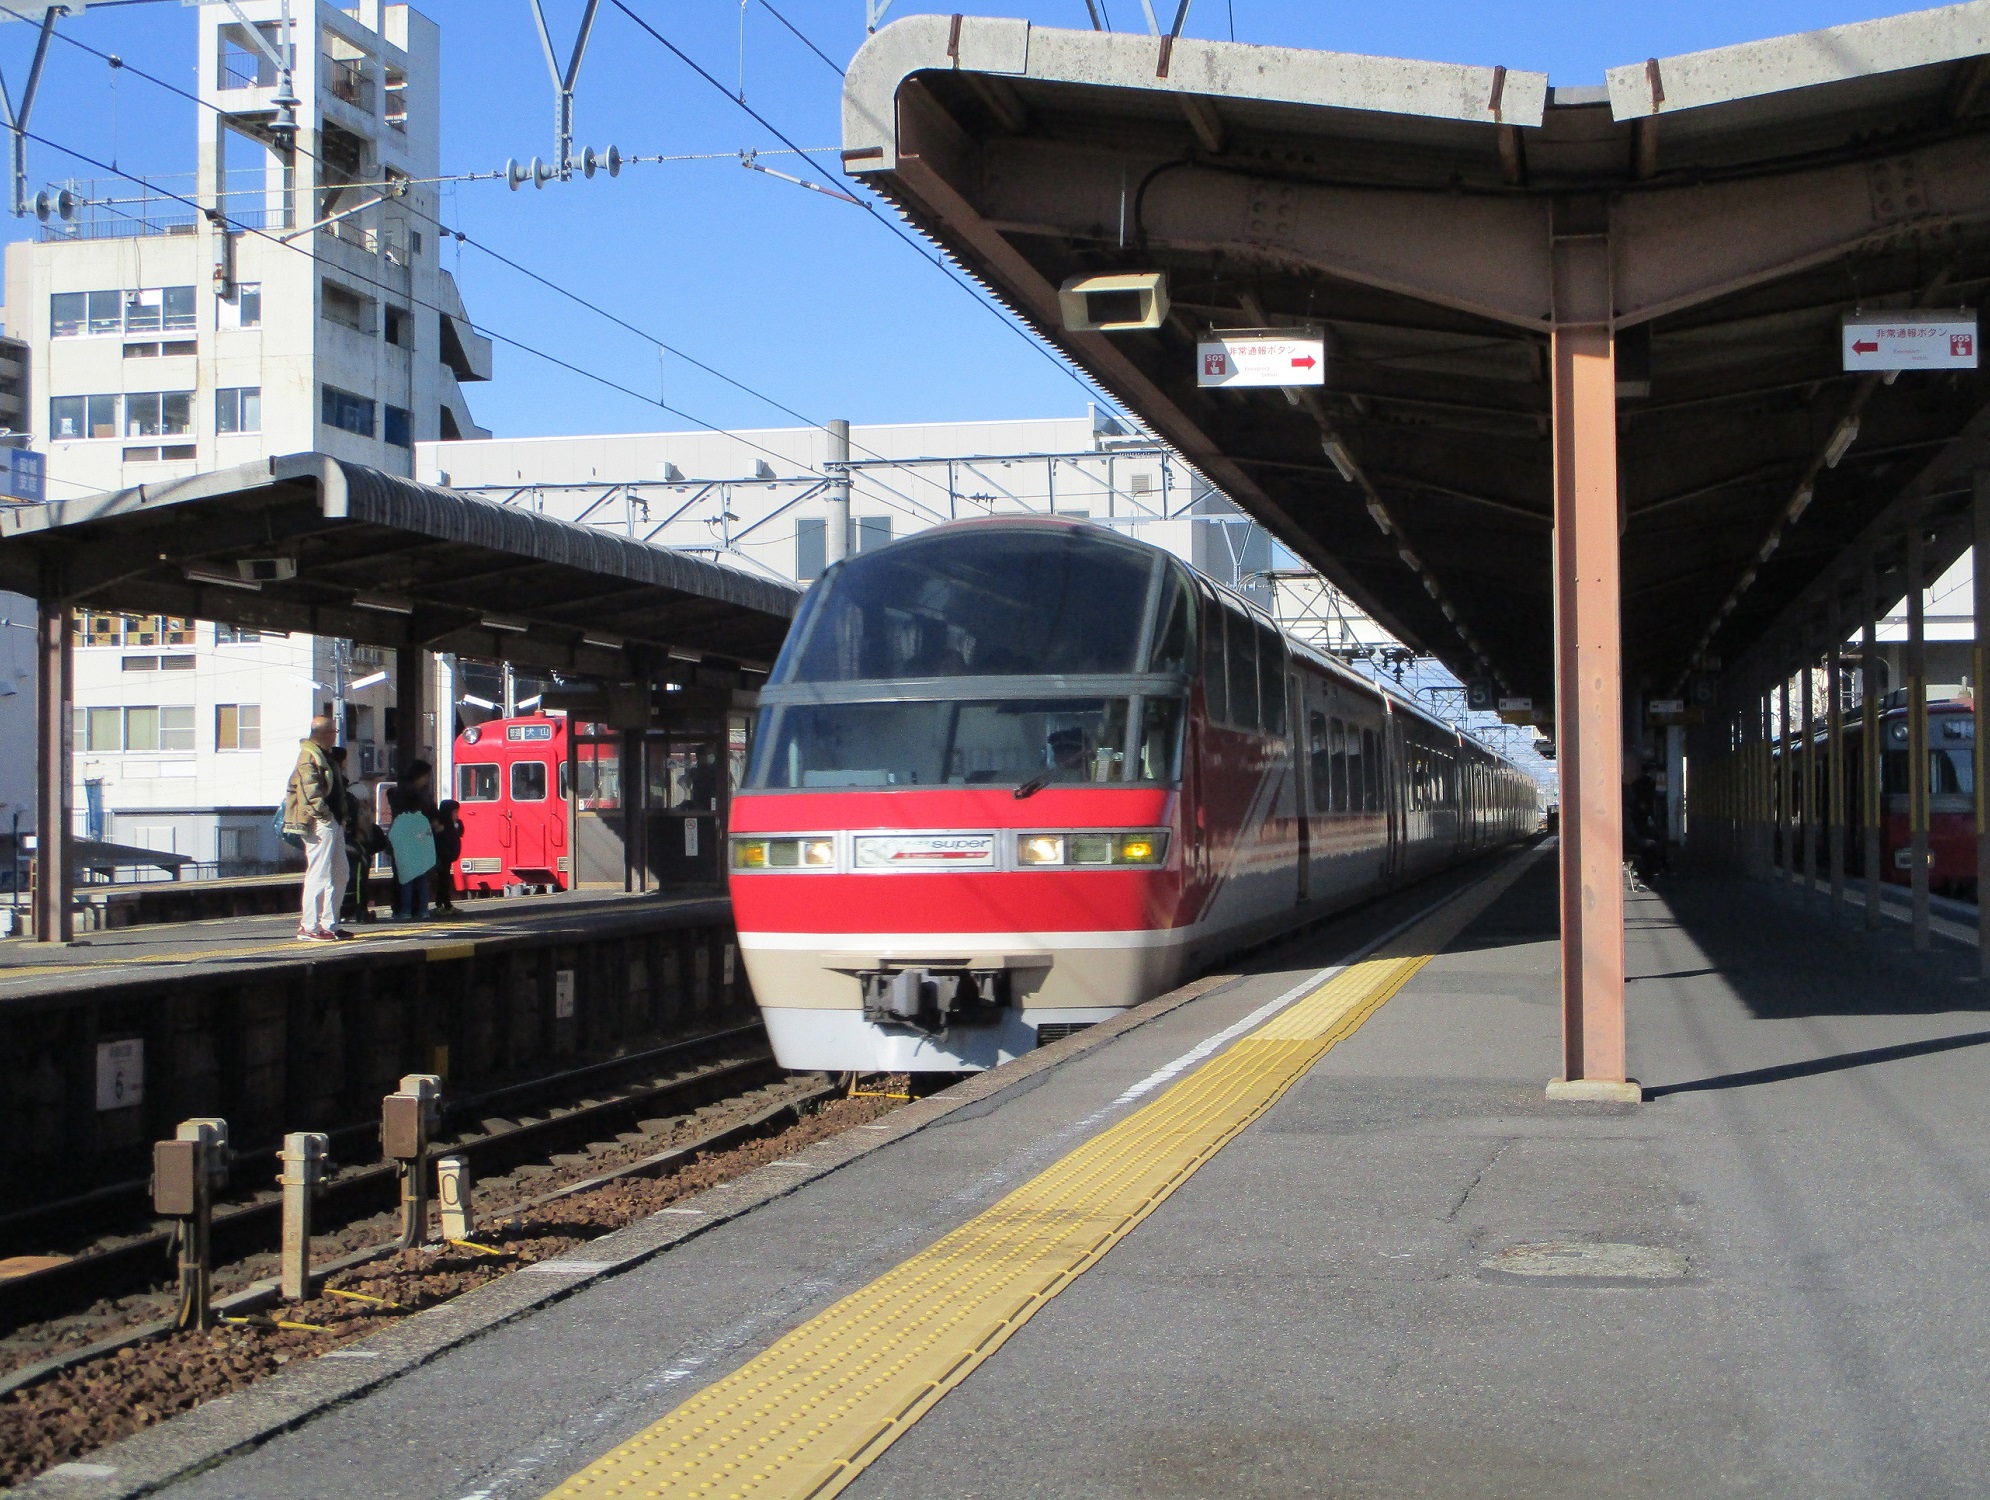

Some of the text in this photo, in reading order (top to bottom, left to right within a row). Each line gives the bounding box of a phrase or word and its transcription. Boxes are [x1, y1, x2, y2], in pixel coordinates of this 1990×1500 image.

[1876, 328, 1948, 339] 非常通報ボタン
[1229, 345, 1296, 355] 非常通報ボタン
[1206, 354, 1224, 362] SOS
[1473, 685, 1486, 703] 5
[931, 839, 991, 850] super
